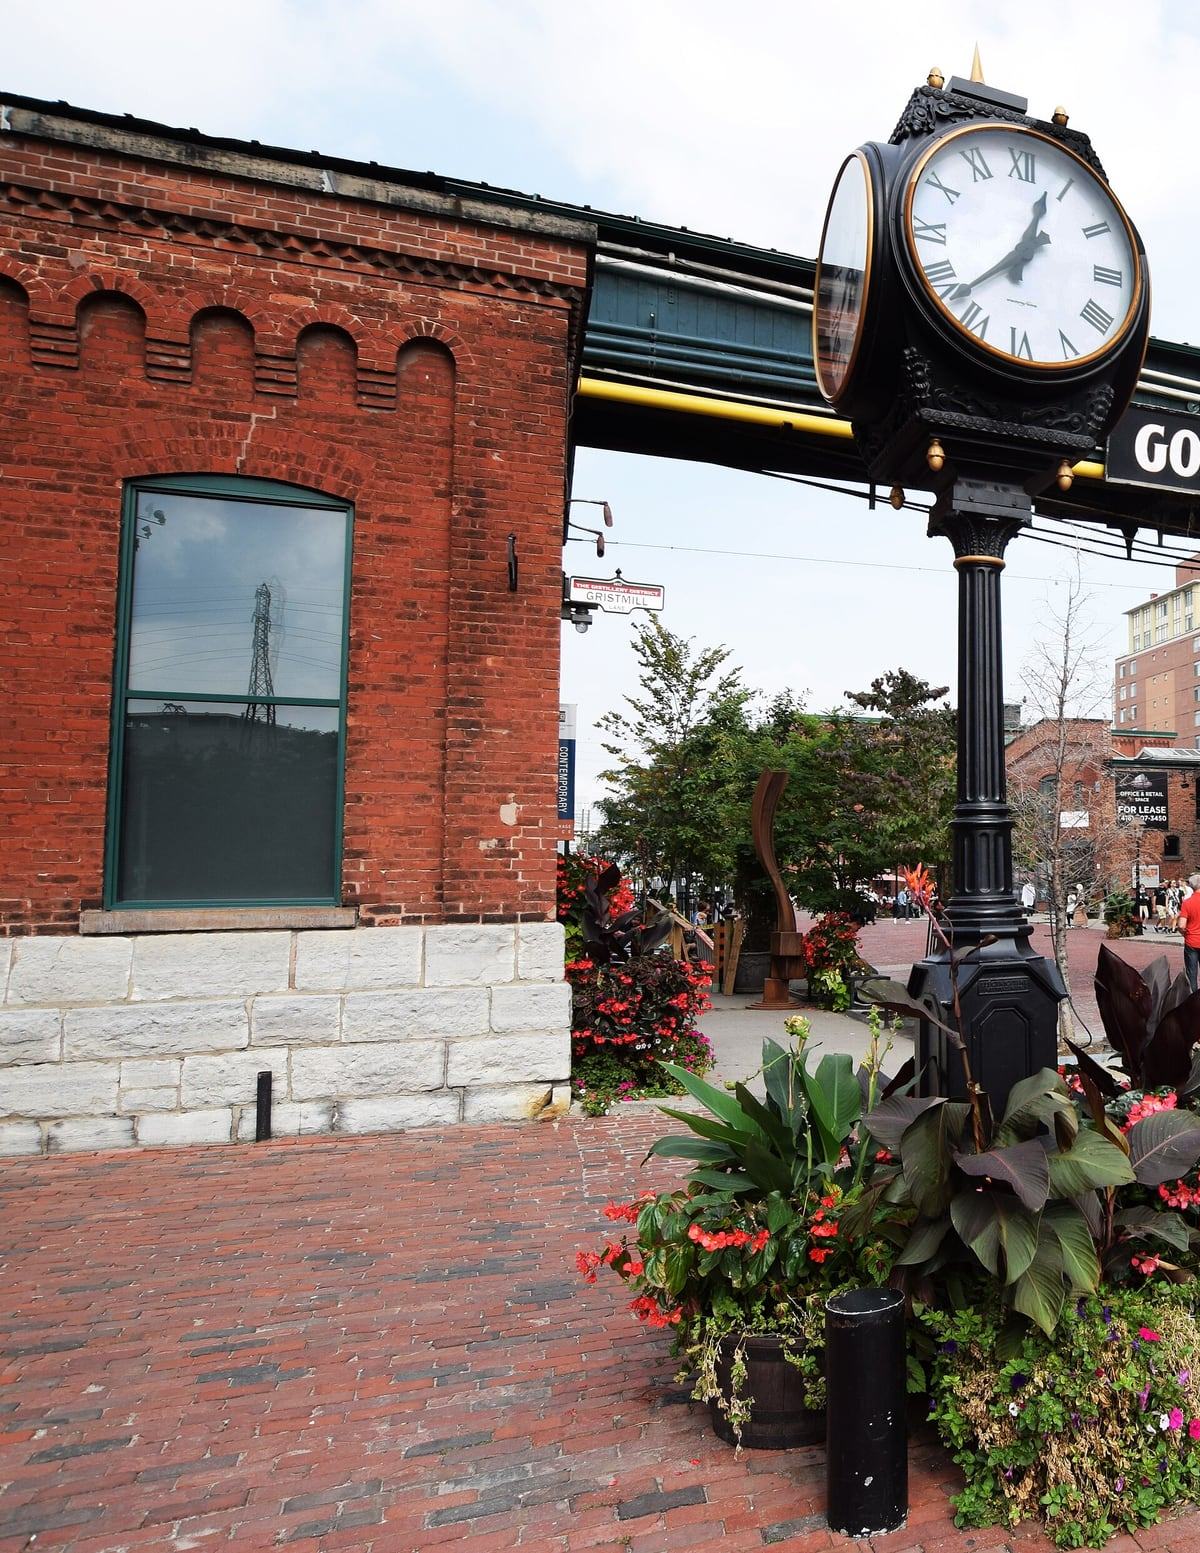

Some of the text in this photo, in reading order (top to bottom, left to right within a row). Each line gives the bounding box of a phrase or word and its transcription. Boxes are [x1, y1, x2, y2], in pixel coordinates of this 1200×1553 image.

[1008, 147, 1037, 184] XII
[925, 171, 961, 205] X
[1093, 264, 1123, 289] III
[586, 592, 648, 606] GRISTMILL
[591, 584, 629, 593] DISTILLERY
[558, 746, 569, 813] CONTEMPORARY
[1118, 806, 1166, 814] FOR LEASE
